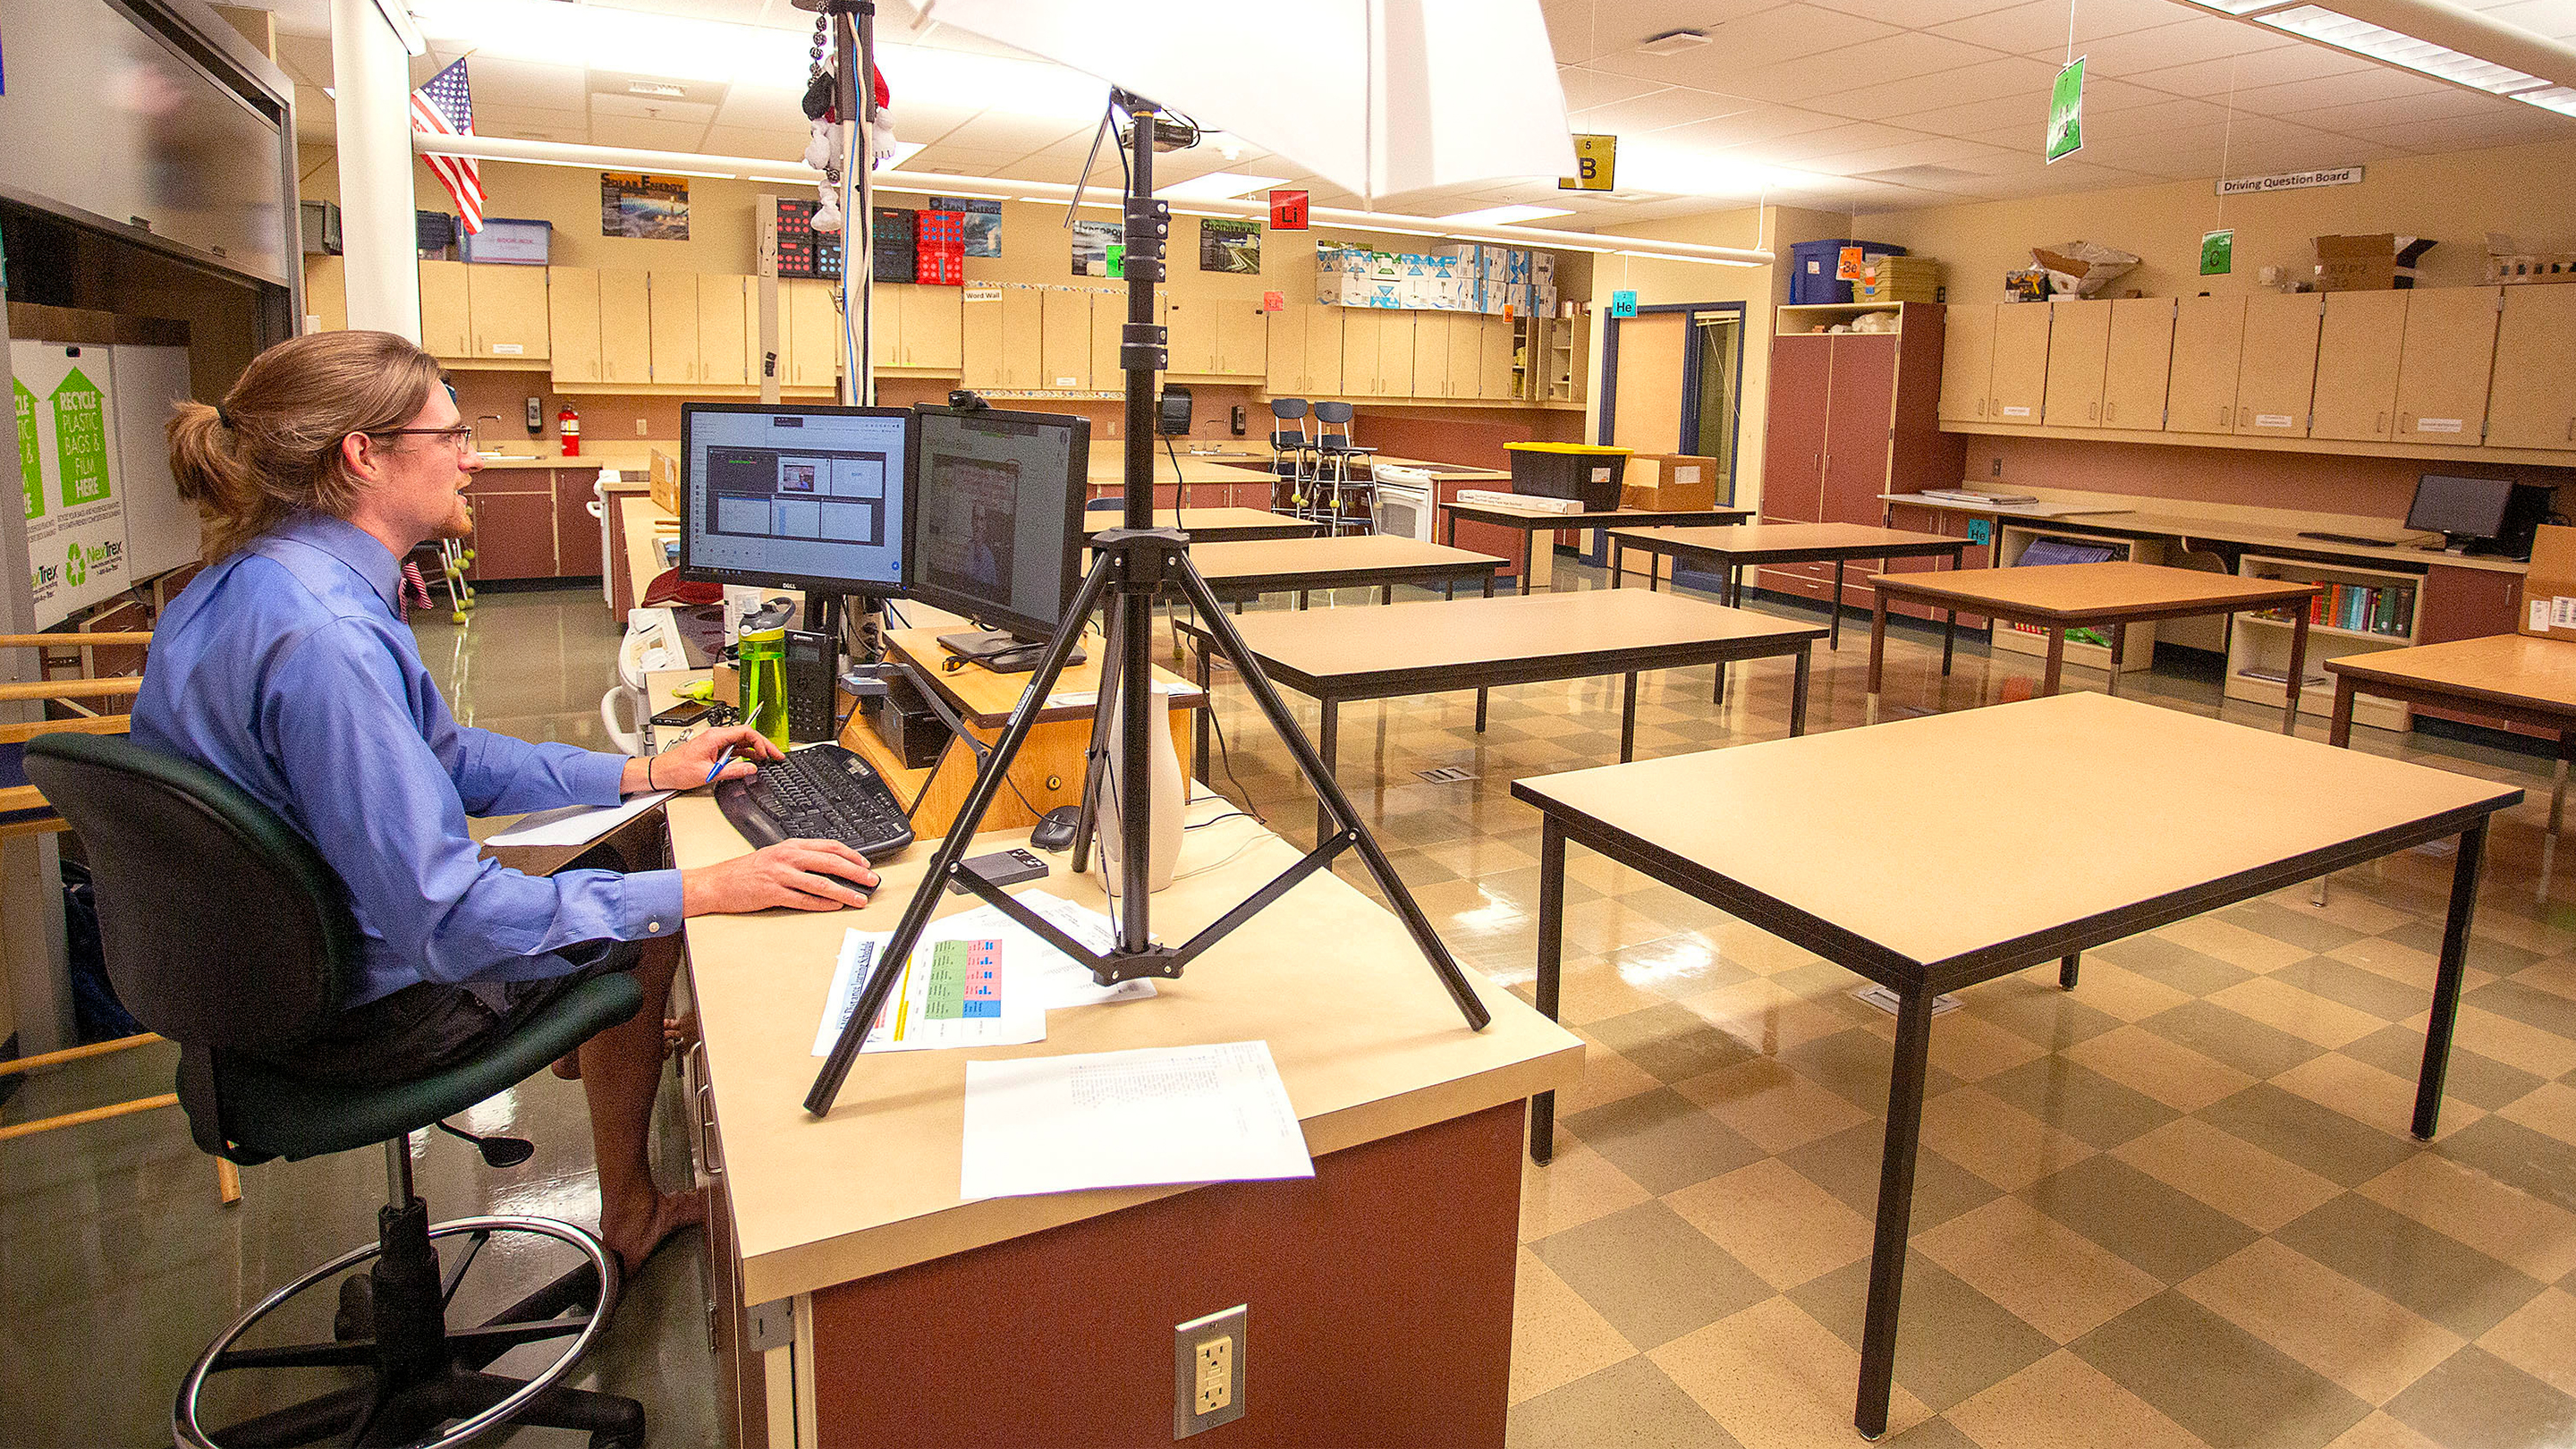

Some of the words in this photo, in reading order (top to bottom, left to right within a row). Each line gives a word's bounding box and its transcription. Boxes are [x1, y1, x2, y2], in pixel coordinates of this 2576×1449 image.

[1585, 140, 1592, 150] 5
[1579, 157, 1597, 180] B
[2224, 181, 2261, 192] Driving
[2264, 175, 2313, 189] Question
[2315, 170, 2350, 182] Board
[1282, 207, 1298, 223] Li
[1843, 260, 1858, 274] Be
[2209, 250, 2221, 267] C
[1616, 301, 1632, 313] He
[59, 391, 97, 411] RECYCLE
[63, 411, 98, 433] PLASTIC
[64, 435, 90, 456] BAGS
[93, 433, 100, 452] &
[75, 457, 96, 476] FILM
[75, 477, 99, 499] HERE
[1970, 529, 1987, 541] He
[86, 541, 123, 564] NexTrex
